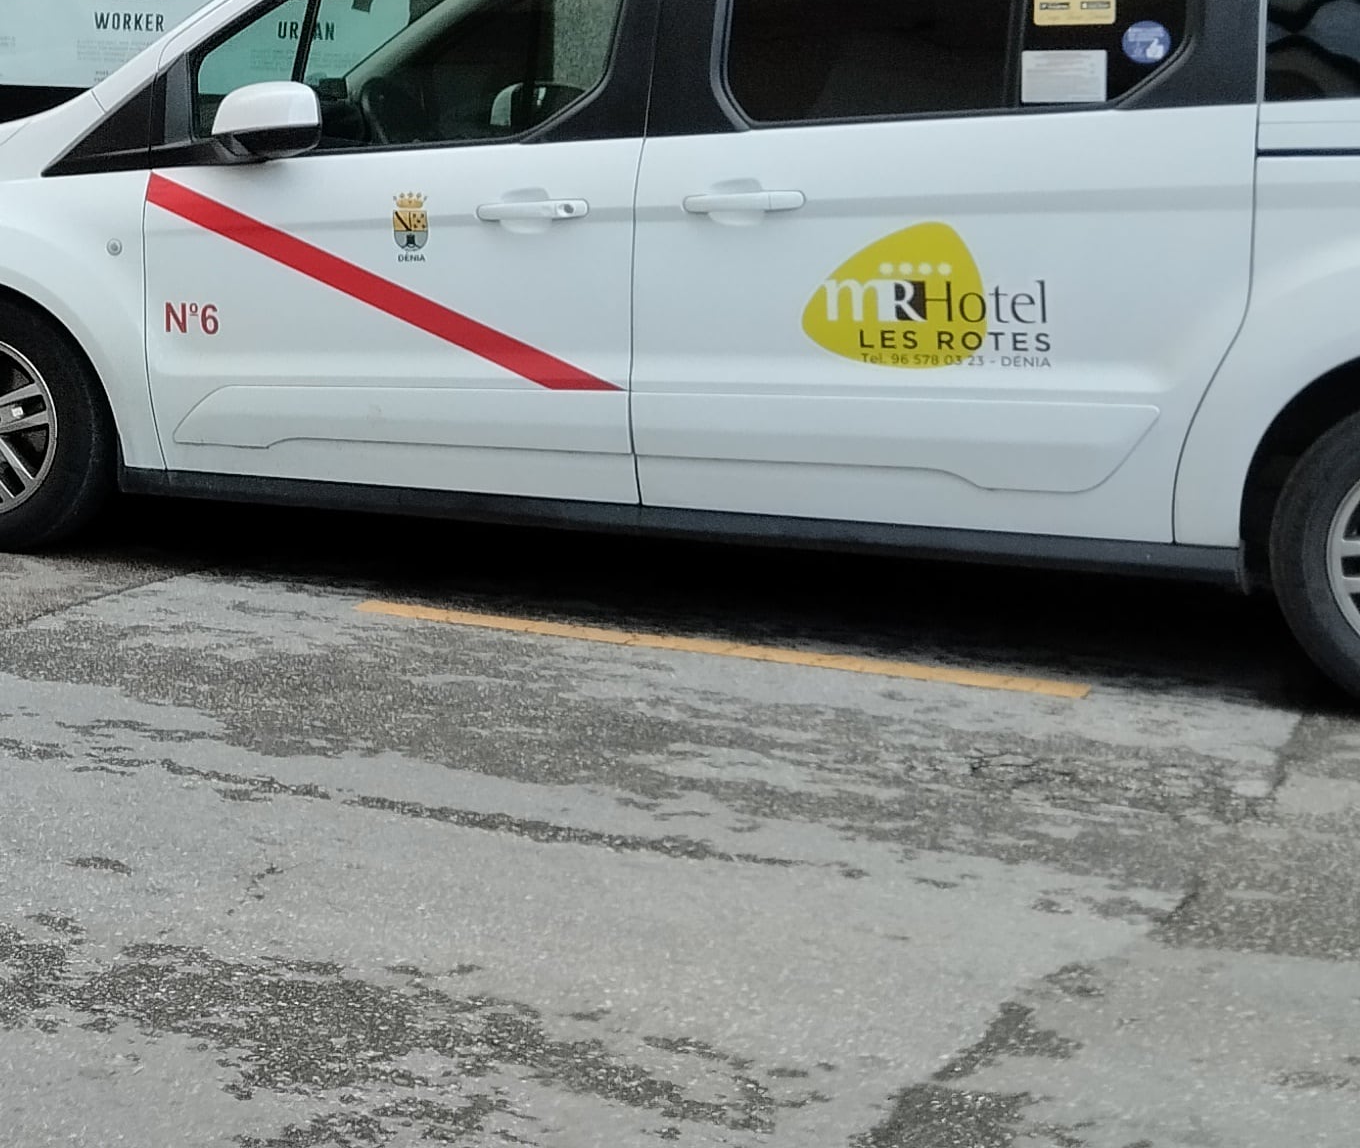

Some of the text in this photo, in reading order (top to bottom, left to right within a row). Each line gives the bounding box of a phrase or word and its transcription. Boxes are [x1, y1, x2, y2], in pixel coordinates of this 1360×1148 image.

[94, 11, 164, 32] WORKER
[278, 20, 335, 41] URAN
[859, 330, 1051, 352] LES ROTES
[860, 353, 883, 364] Tel.
[892, 353, 909, 364] 96
[914, 354, 940, 365] 578
[944, 355, 962, 366] 03
[967, 355, 985, 366] 23
